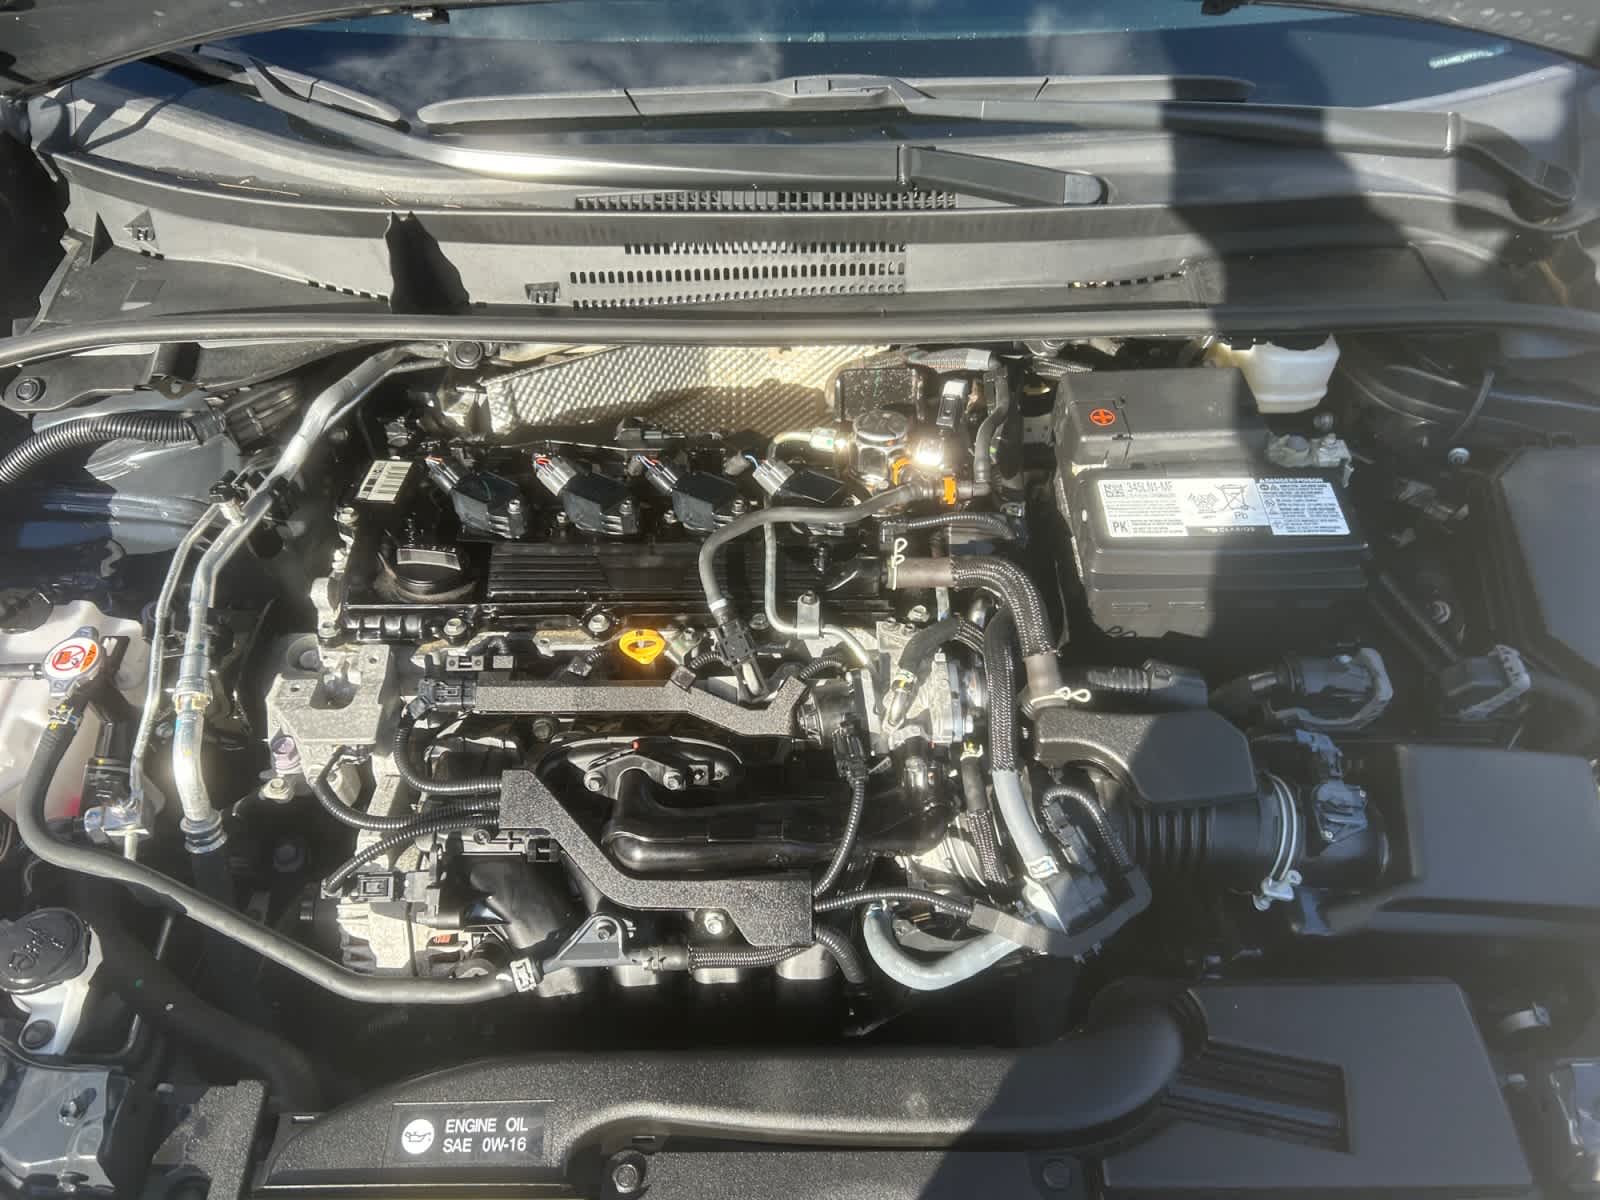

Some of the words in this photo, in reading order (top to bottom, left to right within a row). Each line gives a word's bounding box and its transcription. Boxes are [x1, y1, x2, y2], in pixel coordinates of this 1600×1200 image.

[1234, 511, 1248, 520] Pb
[1112, 521, 1128, 533] PK
[445, 1117, 497, 1133] ENGINE
[505, 1116, 528, 1132] OIL
[442, 1137, 472, 1153] SAE
[482, 1137, 526, 1152] 0W-16
